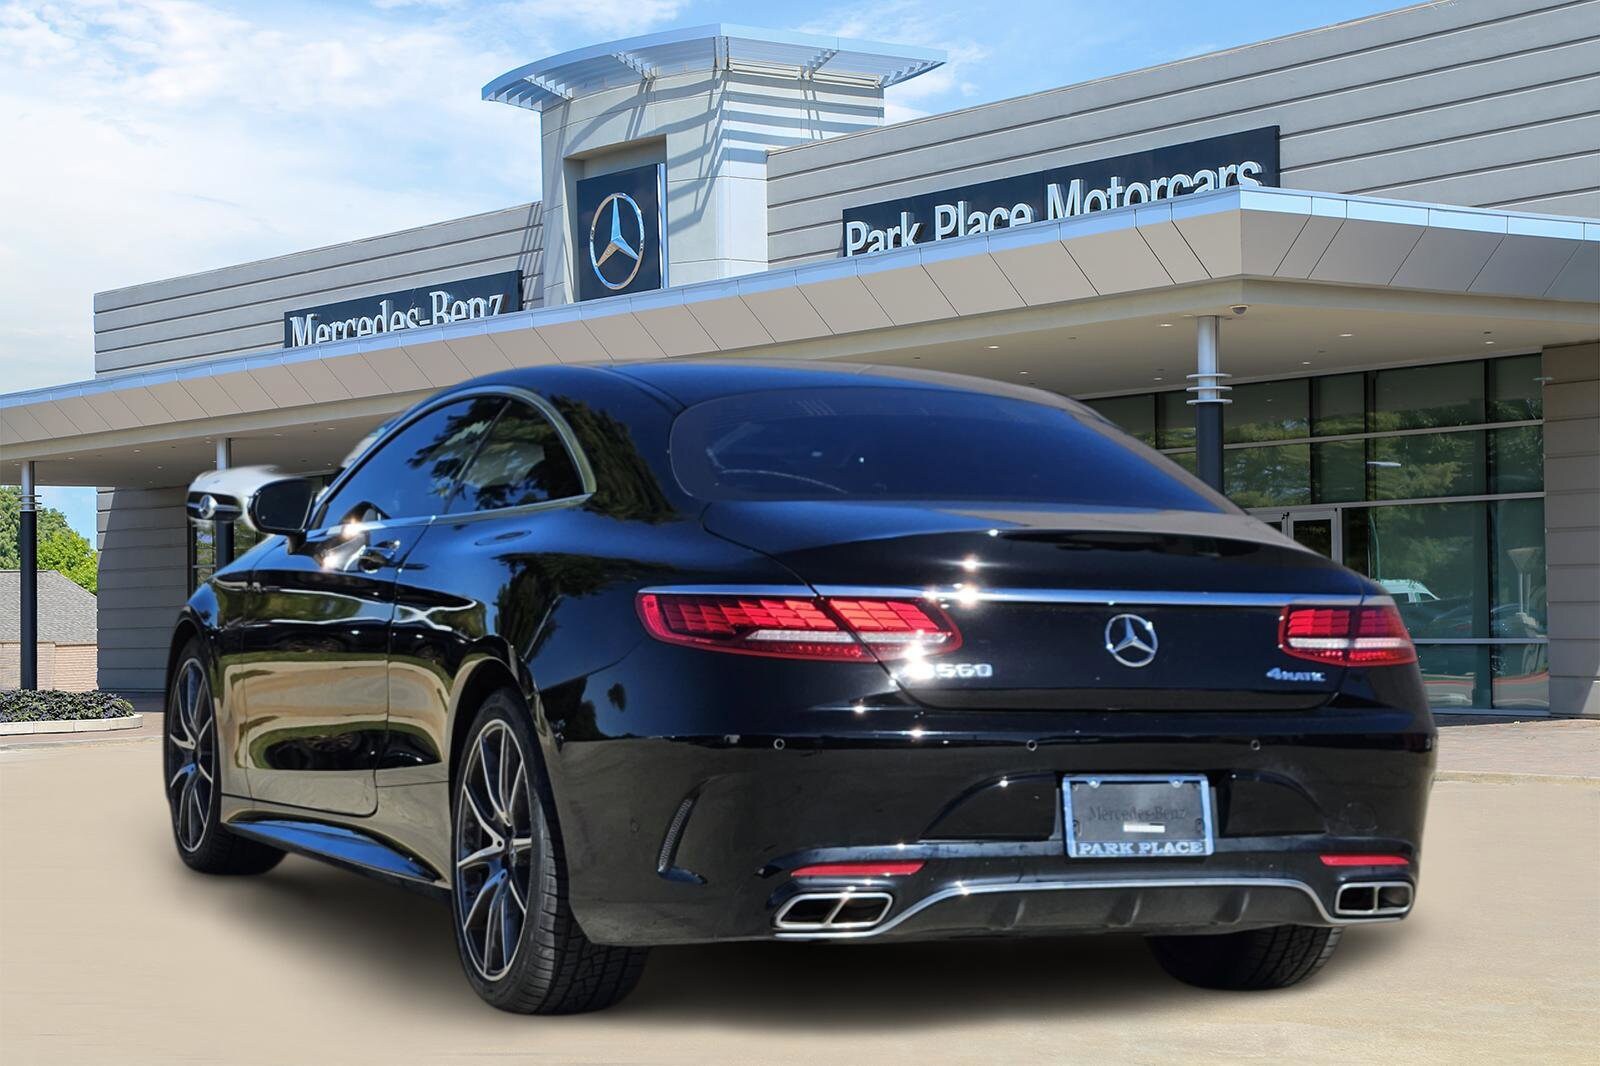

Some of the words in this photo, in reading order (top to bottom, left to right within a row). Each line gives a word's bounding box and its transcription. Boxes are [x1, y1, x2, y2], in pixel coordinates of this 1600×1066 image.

[845, 211, 922, 257] Park
[934, 200, 1035, 241] Place
[1046, 160, 1263, 222] Motorcars
[290, 290, 505, 348] Mercedes-Benz
[1087, 805, 1186, 821] Mercedes-Benz
[1078, 841, 1135, 856] PARK
[1138, 841, 1203, 855] PLACE
